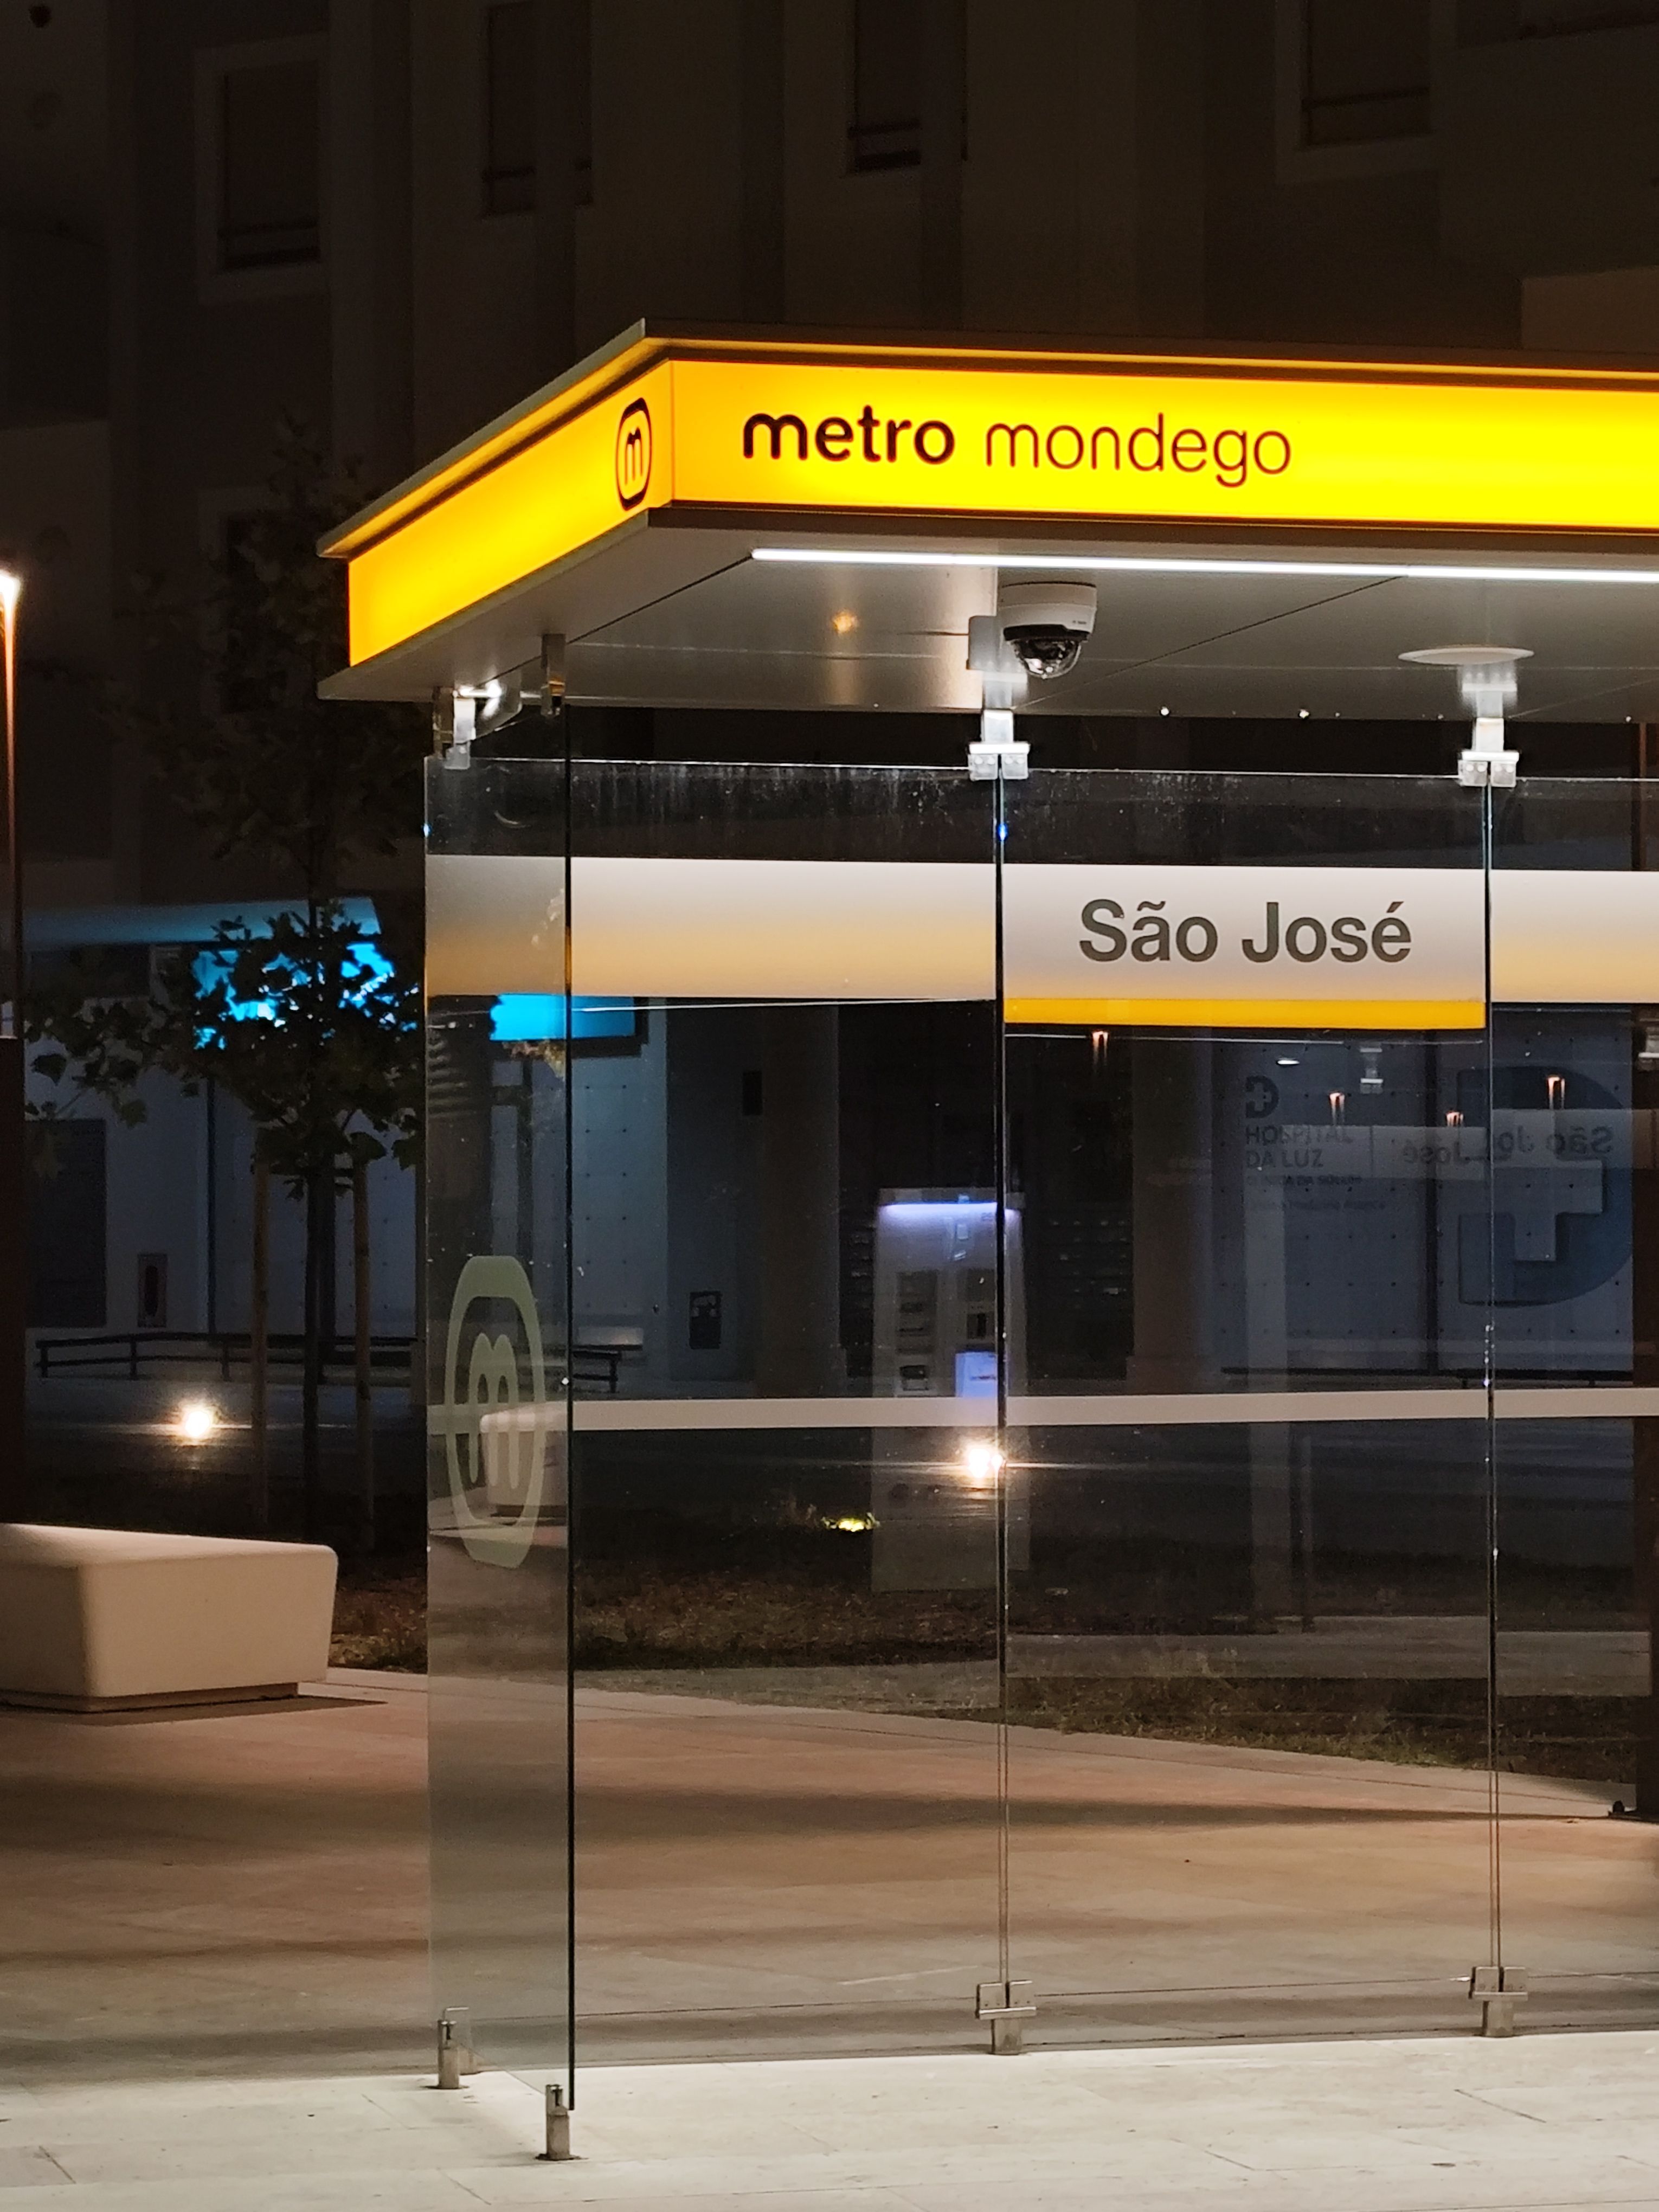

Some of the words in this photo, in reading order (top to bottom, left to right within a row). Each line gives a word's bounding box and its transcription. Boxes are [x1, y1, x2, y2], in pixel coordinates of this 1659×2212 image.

[743, 404, 955, 465] metro
[986, 412, 1291, 488] mondego
[1079, 899, 1218, 962] São
[1242, 901, 1411, 963] José
[1246, 1149, 1276, 1168] DA
[1282, 1149, 1324, 1168] LUZ
